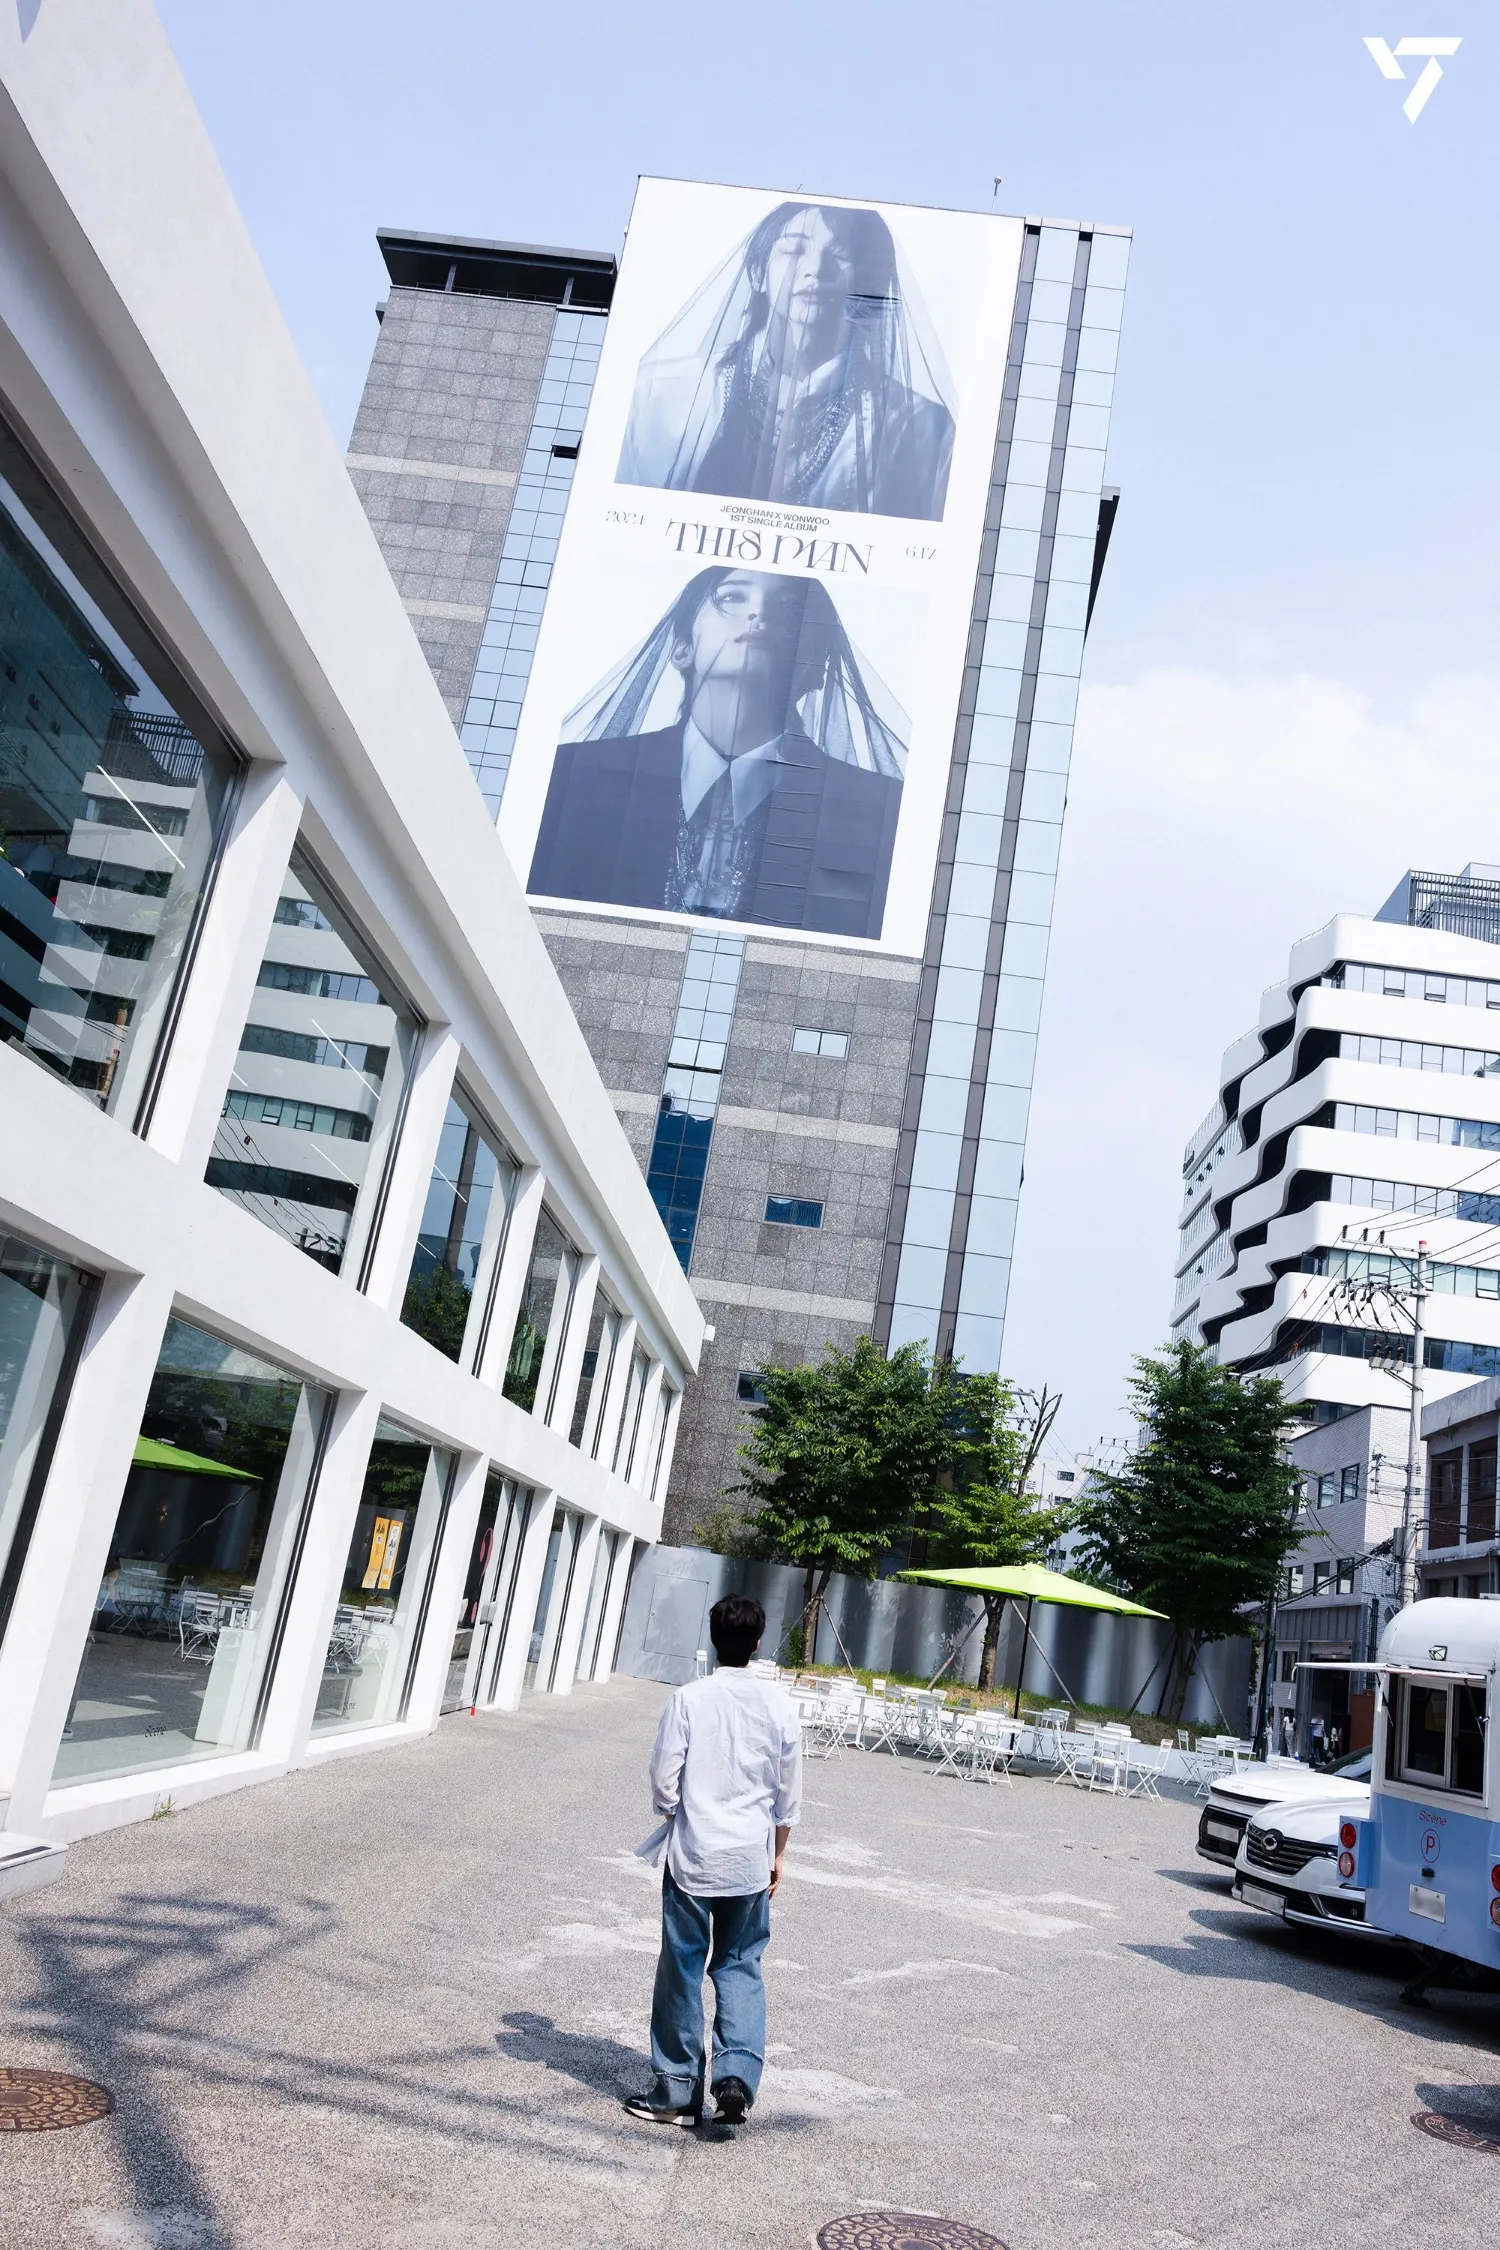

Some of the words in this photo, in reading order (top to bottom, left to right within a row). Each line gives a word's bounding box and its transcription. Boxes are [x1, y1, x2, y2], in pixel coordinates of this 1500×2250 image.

[720, 505, 774, 519] JEONGHAN
[774, 512, 782, 520] X
[783, 513, 830, 526] WONWOO
[730, 514, 747, 523] 1ST
[747, 516, 783, 528] SINGLE
[784, 520, 818, 532] ALBUM
[664, 518, 762, 561] THIS
[905, 545, 937, 560] 6.17
